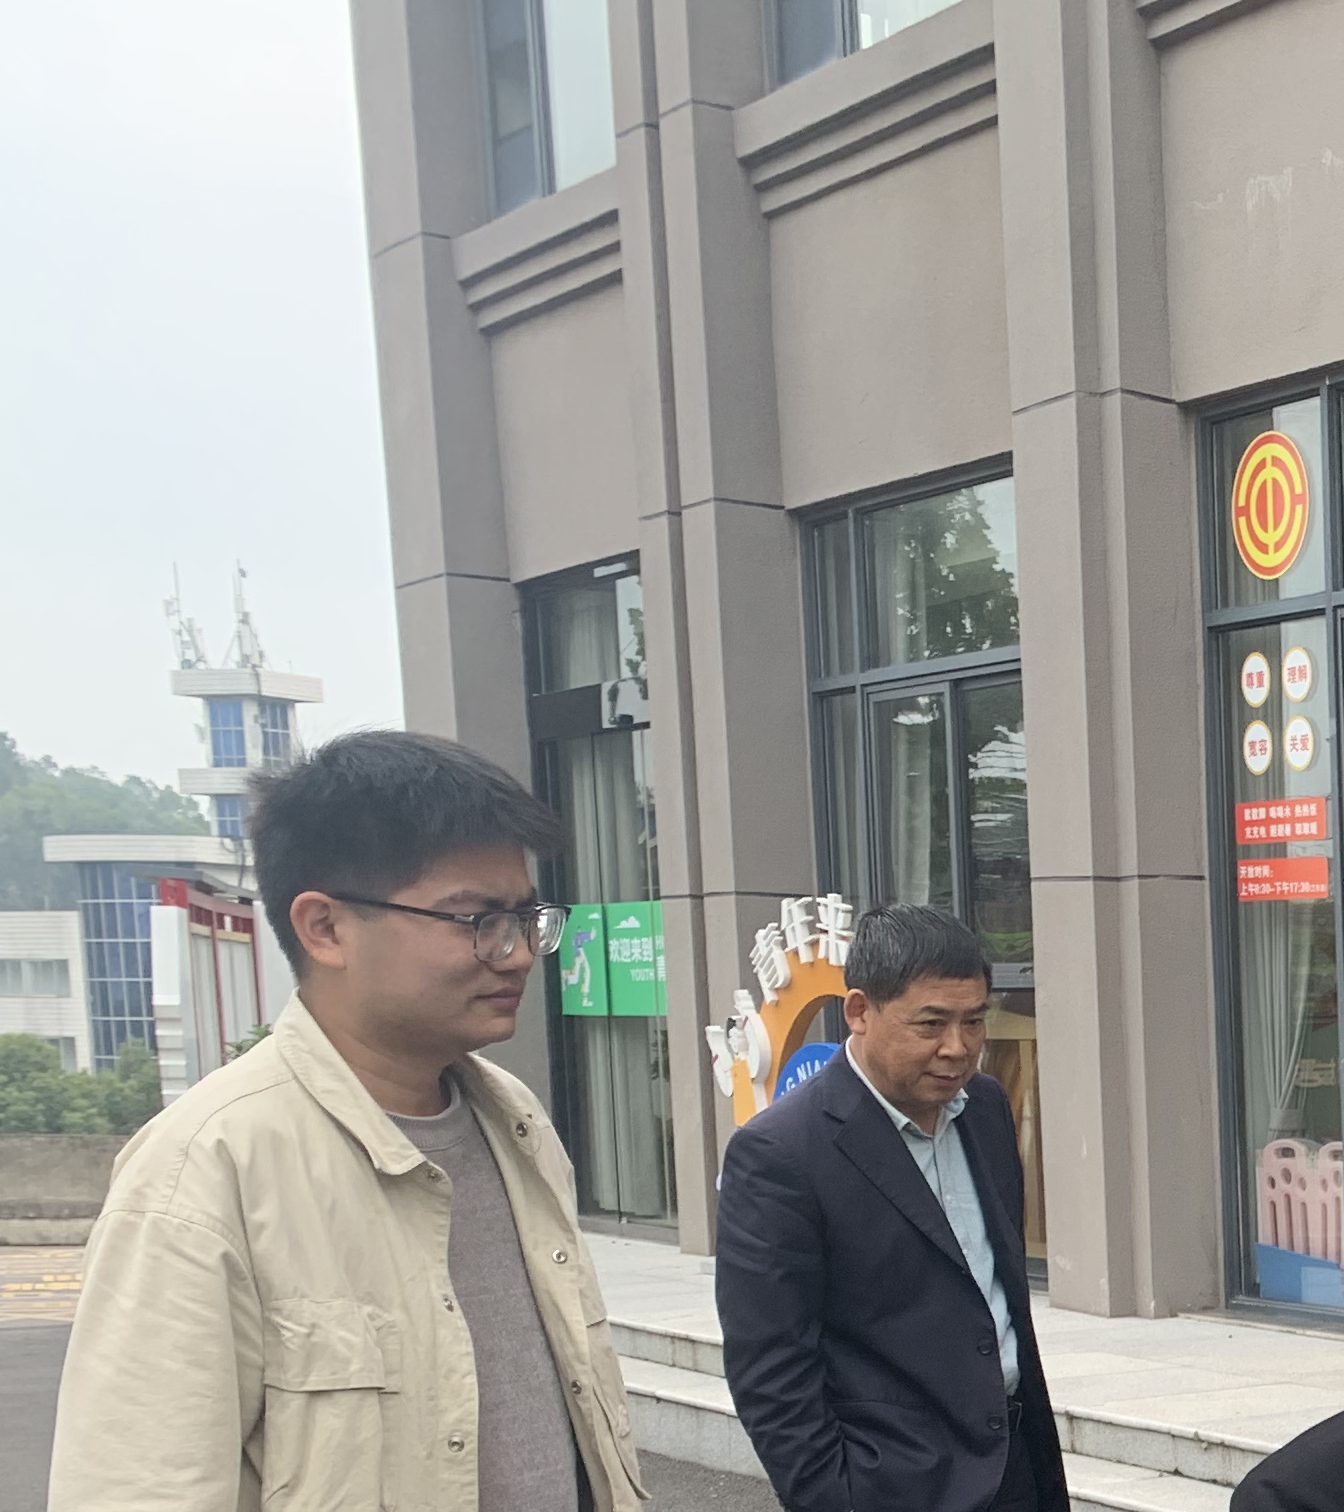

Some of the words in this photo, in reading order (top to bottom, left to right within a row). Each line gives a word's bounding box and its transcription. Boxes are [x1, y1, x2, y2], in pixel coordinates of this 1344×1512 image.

[1287, 664, 1307, 684] 理解
[1248, 739, 1267, 757] 宽容
[1290, 734, 1309, 752] 关爱
[796, 1055, 829, 1081] NIA
